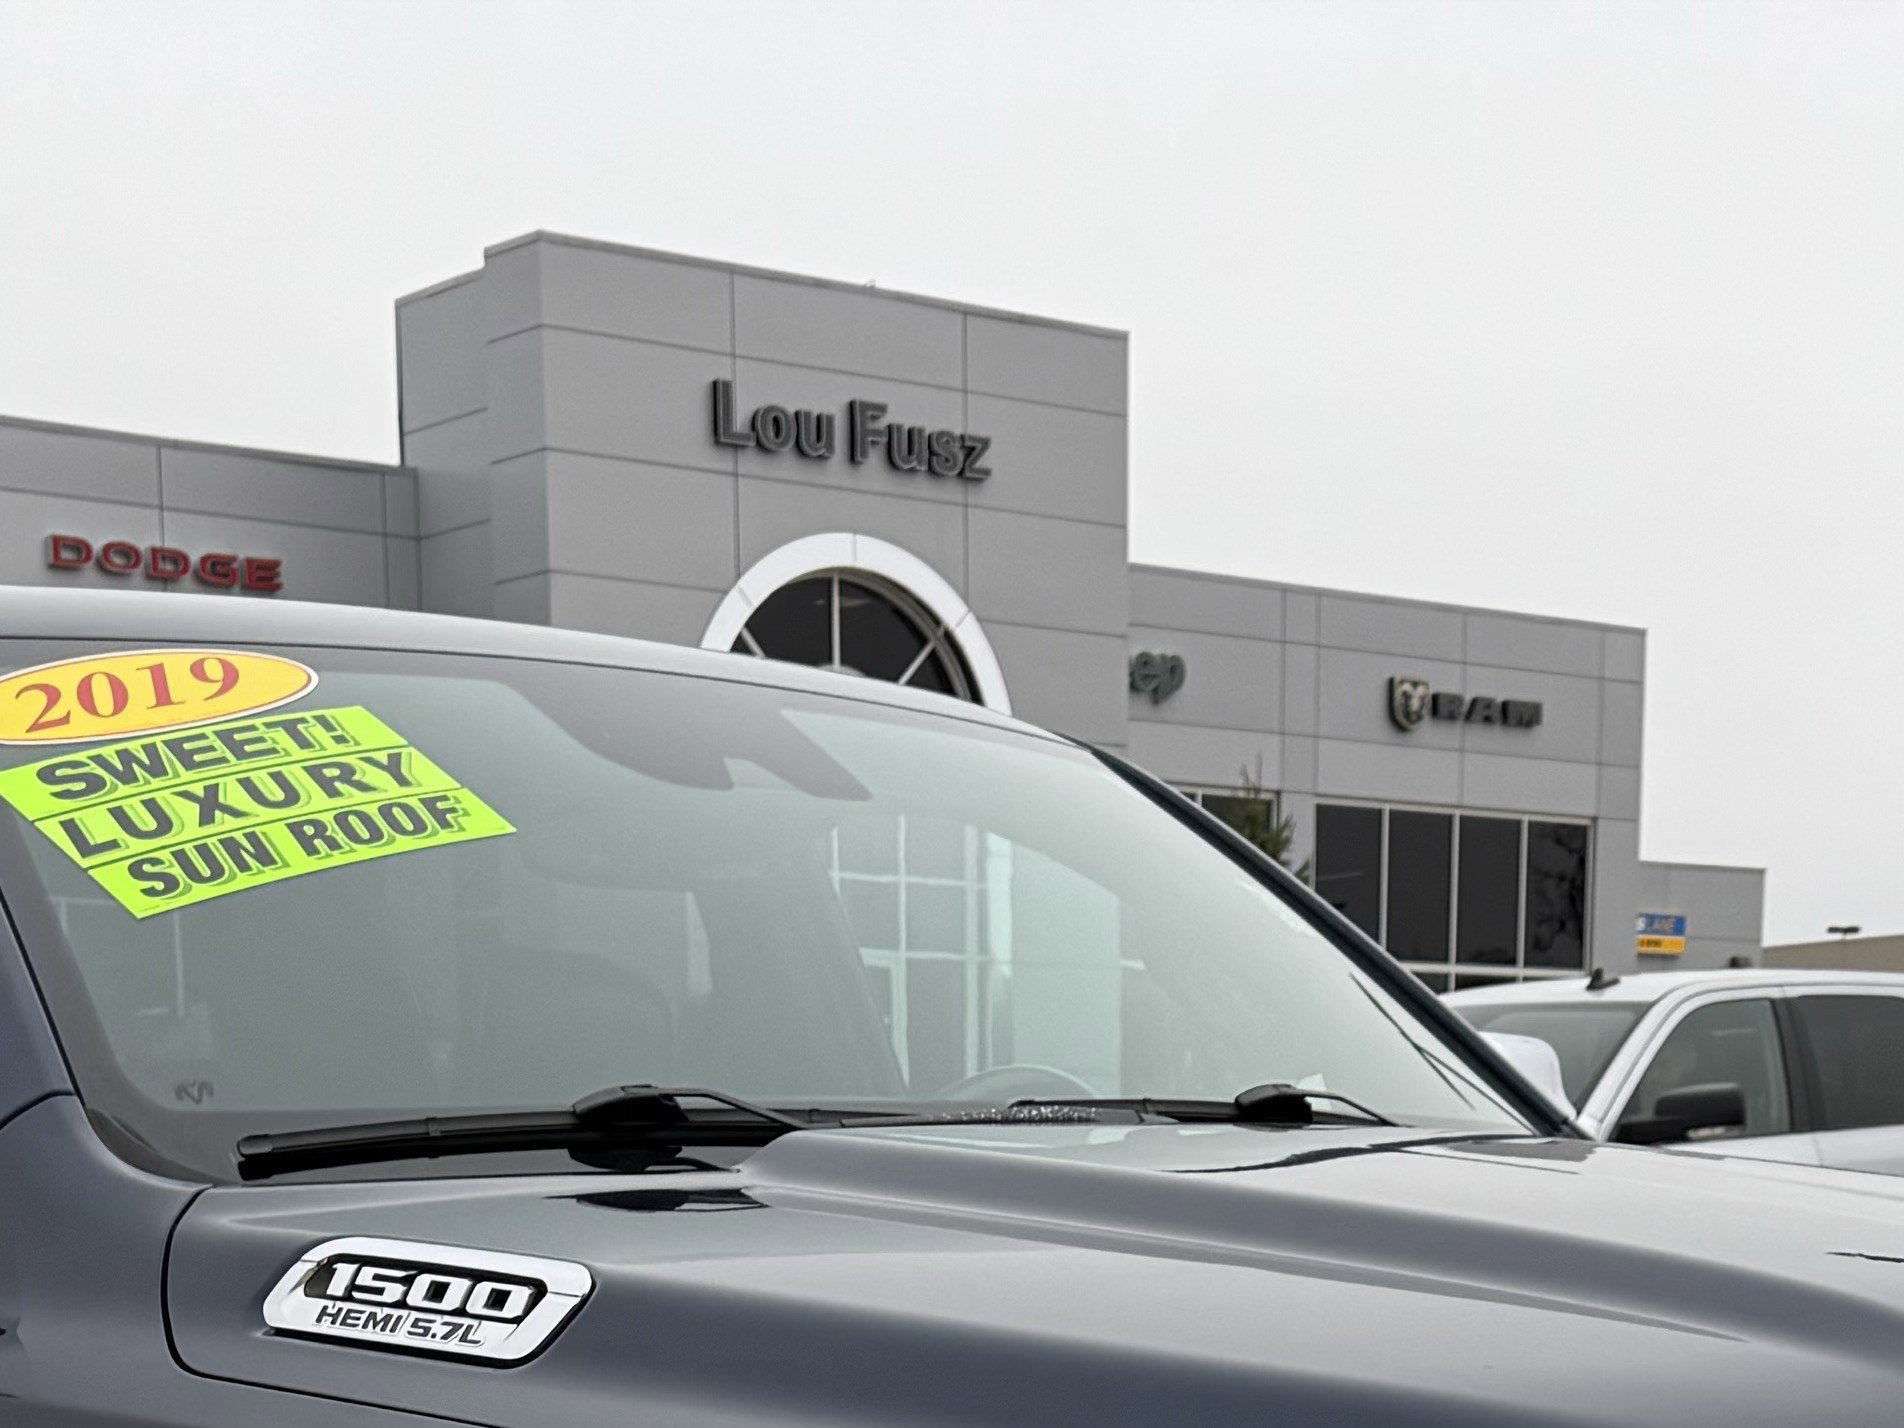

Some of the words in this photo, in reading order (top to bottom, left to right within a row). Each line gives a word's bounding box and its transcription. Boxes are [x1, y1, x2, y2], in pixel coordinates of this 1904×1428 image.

[712, 377, 836, 459] Lou
[849, 399, 993, 481] Fusz
[47, 533, 285, 593] DODGE
[14, 656, 240, 734] 2019
[1431, 691, 1543, 729] RAM
[35, 714, 359, 801] SWEET!
[58, 751, 420, 861] LUXURY
[126, 830, 286, 900] SUN
[287, 793, 471, 860] ROOF
[314, 1304, 404, 1333] HEMI
[406, 1316, 483, 1345] 5.7L
[325, 1262, 534, 1319] 1500
